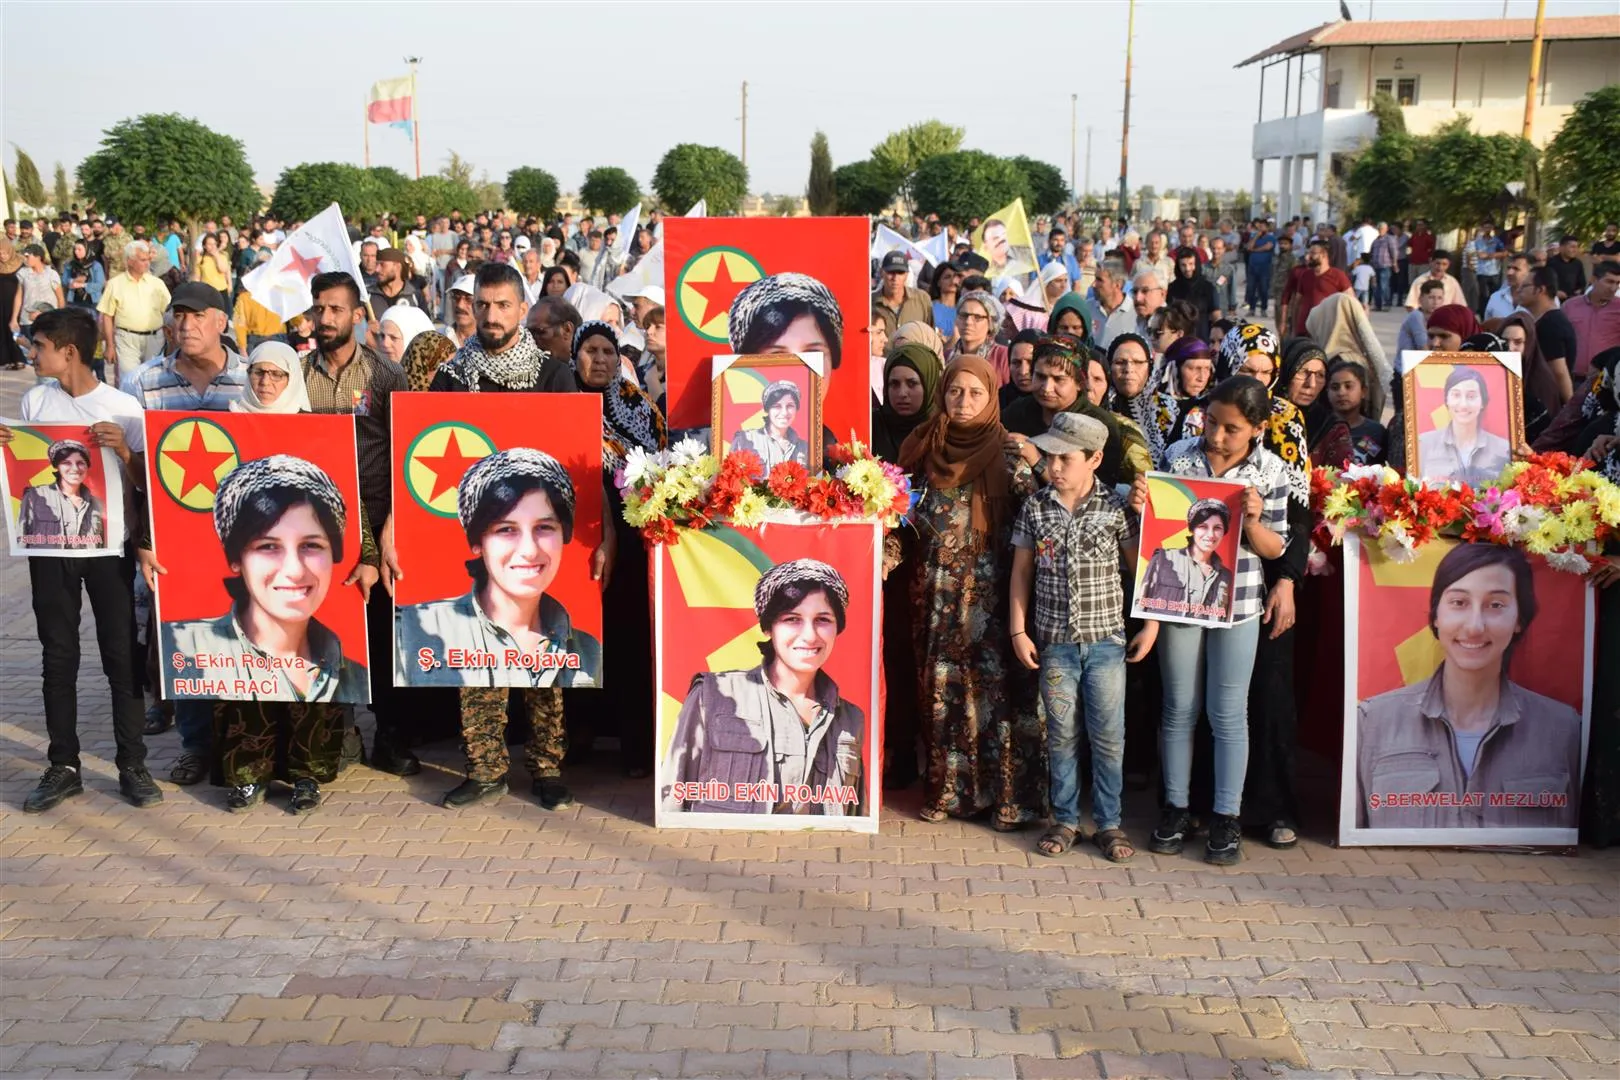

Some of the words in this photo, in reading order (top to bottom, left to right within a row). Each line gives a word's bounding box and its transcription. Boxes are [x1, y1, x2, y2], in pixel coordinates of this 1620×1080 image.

[195, 652, 236, 669] Ekîn
[240, 651, 306, 672] Rojava
[446, 648, 497, 669] Ekîn
[504, 648, 581, 672] Rojava
[174, 679, 228, 695] RUHA
[233, 674, 279, 695] RACÎ
[673, 779, 730, 804] ŞEHÎD
[734, 779, 779, 803] EKÎN
[783, 784, 860, 805] ROJAVA
[1488, 791, 1568, 808] MEZLÛM
